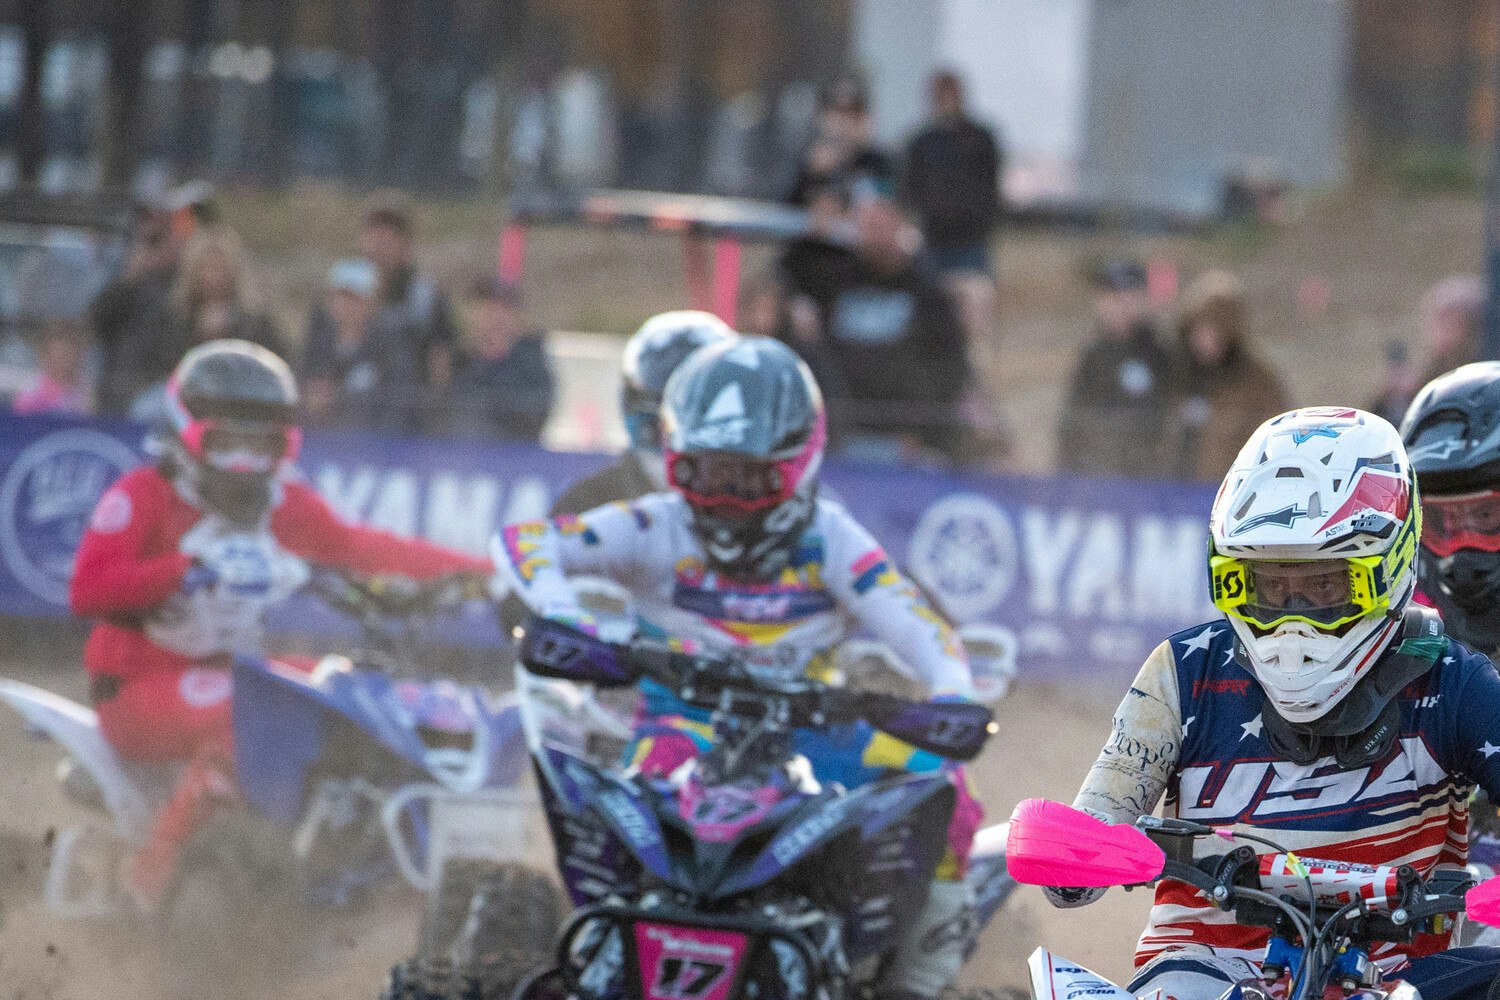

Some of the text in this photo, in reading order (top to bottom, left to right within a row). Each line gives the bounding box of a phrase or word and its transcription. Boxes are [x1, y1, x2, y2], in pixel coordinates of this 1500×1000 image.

[1022, 508, 1209, 618] YAM
[1179, 736, 1449, 820] USA
[653, 955, 730, 1000] 17
